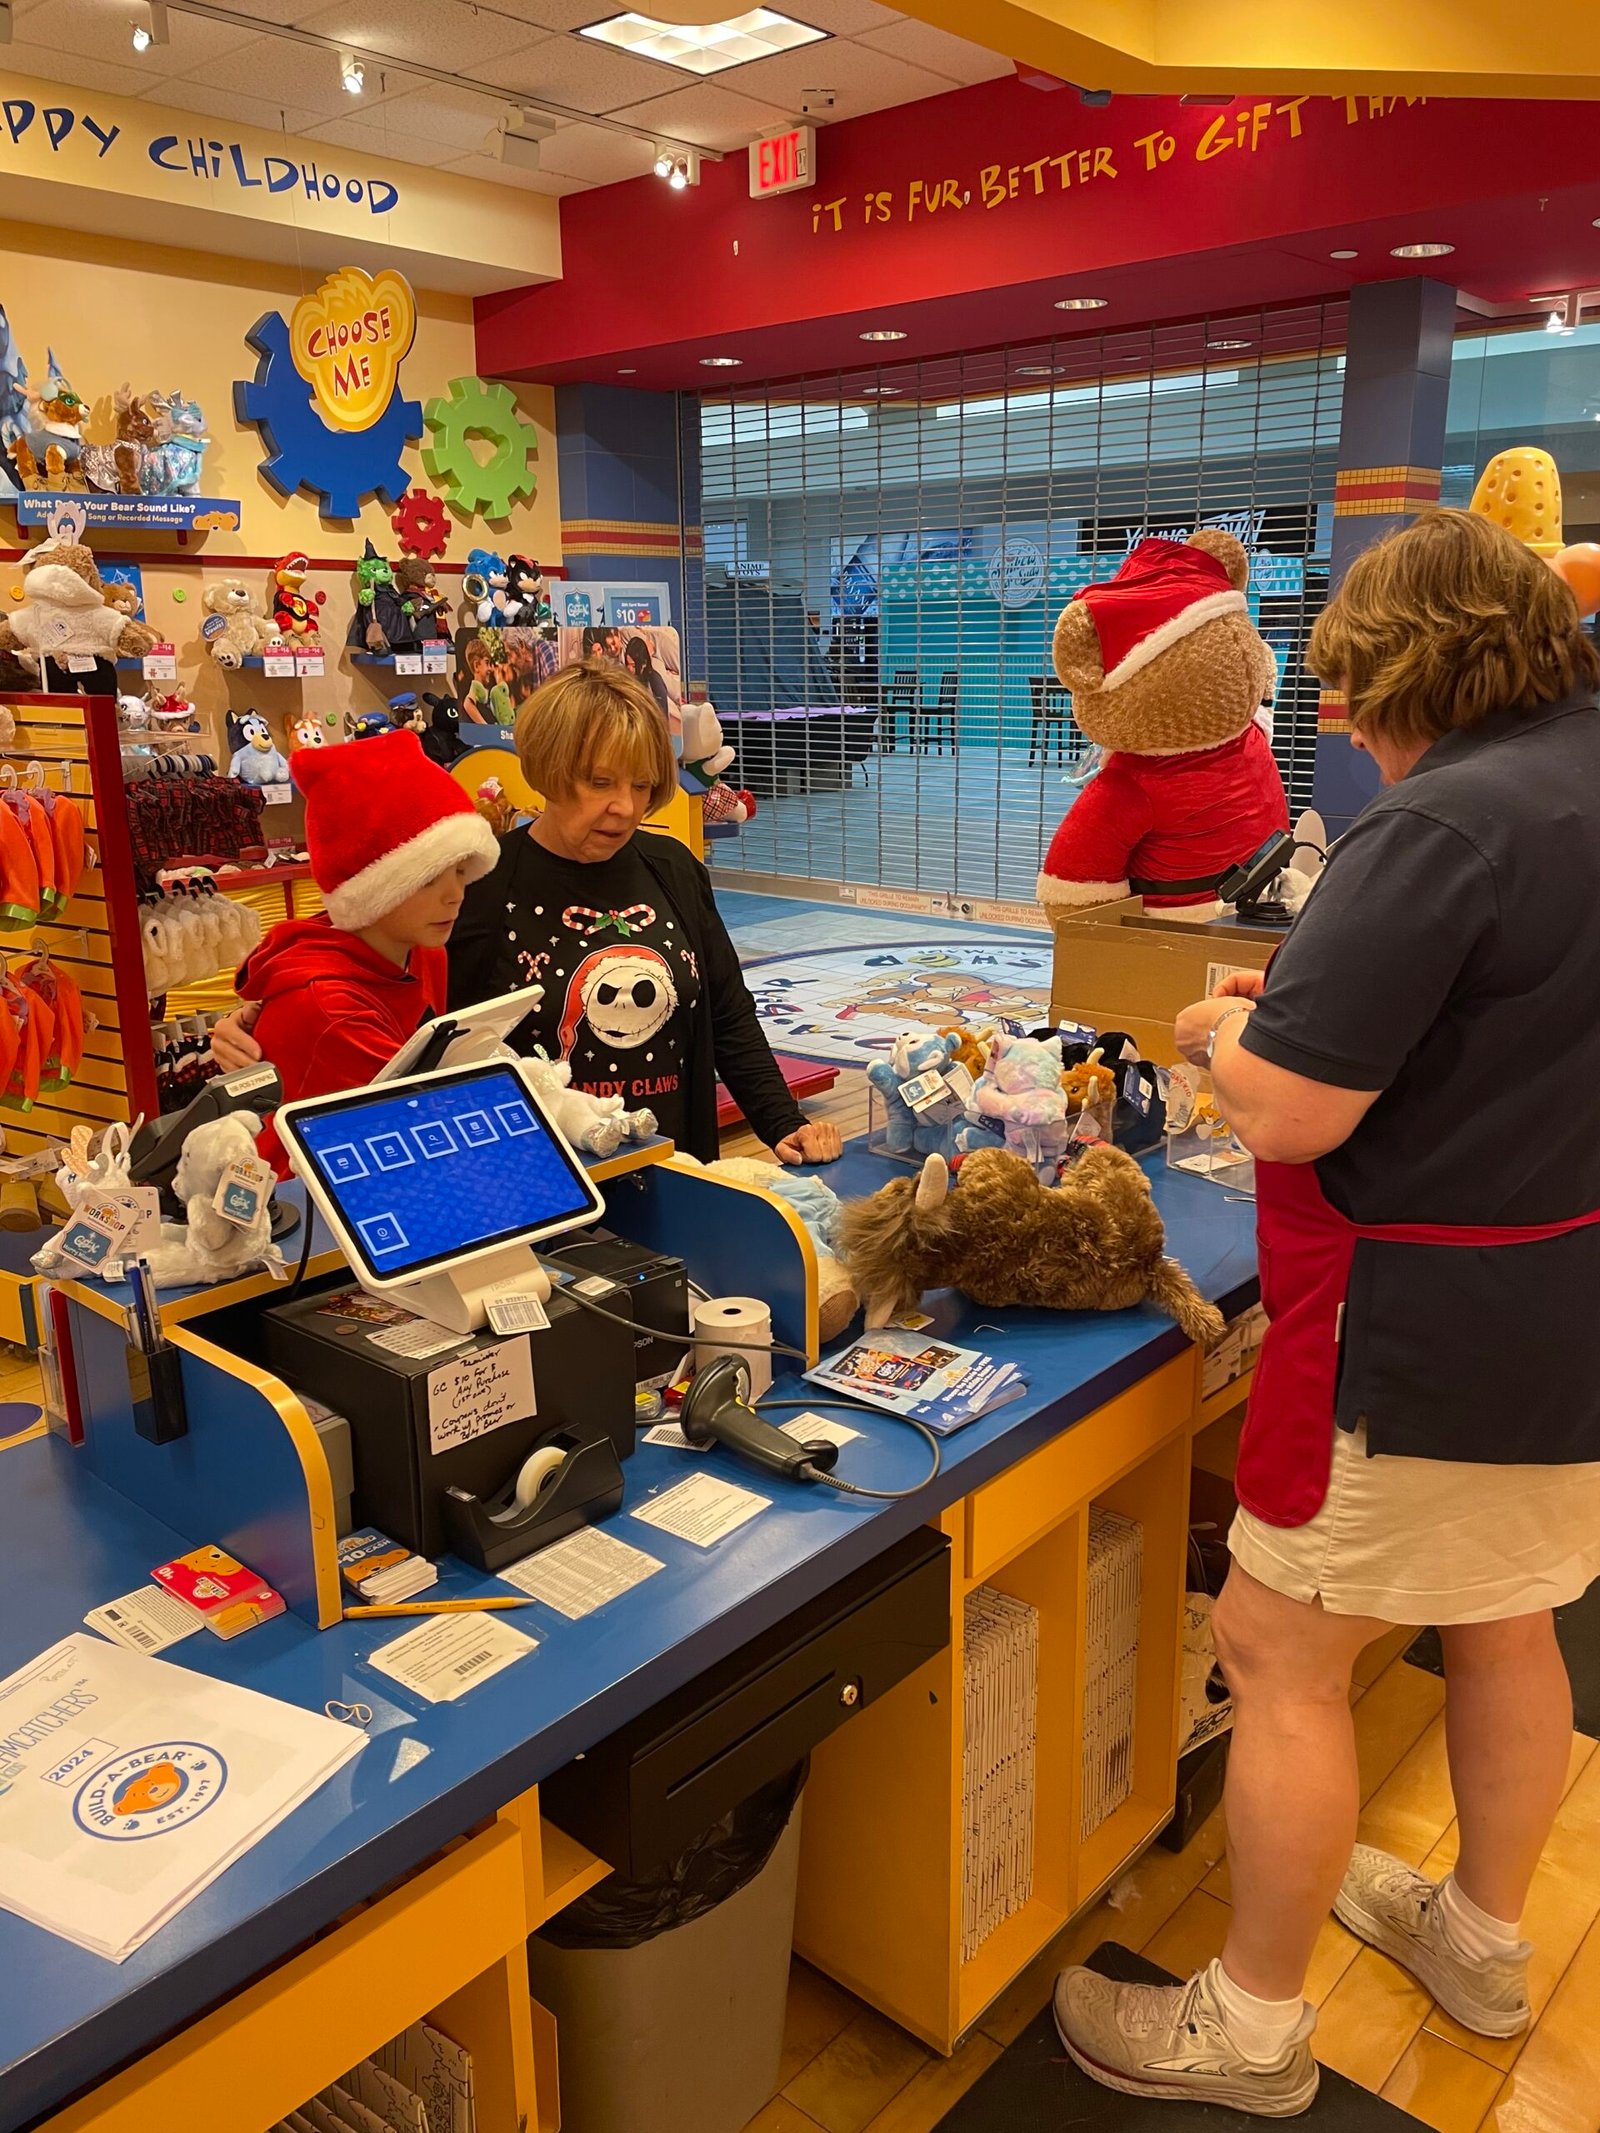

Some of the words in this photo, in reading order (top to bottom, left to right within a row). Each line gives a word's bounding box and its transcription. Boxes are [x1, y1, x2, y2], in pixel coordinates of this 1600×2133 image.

[0, 100, 120, 158] PPY
[759, 131, 799, 190] EXIT
[980, 147, 1118, 209] BETTER
[1133, 130, 1177, 171] TO
[1332, 95, 1427, 125] TH
[308, 307, 391, 358] CHOOSE
[334, 353, 370, 397] ME
[24, 499, 52, 508] What
[55, 500, 81, 509] Ds
[84, 501, 109, 510] Your
[111, 502, 135, 511] Bear
[137, 503, 167, 513] Sound
[170, 504, 196, 514] Like?
[88, 513, 107, 522] Song
[117, 514, 152, 522] Recorded
[152, 515, 183, 524] Message
[617, 609, 636, 623] $10
[632, 1075, 679, 1096] CLAWS
[83, 1204, 126, 1231] WORKSHOP
[365, 1539, 391, 1553] CASH
[49, 1749, 94, 1782] 2024
[189, 1779, 211, 1802] 1997
